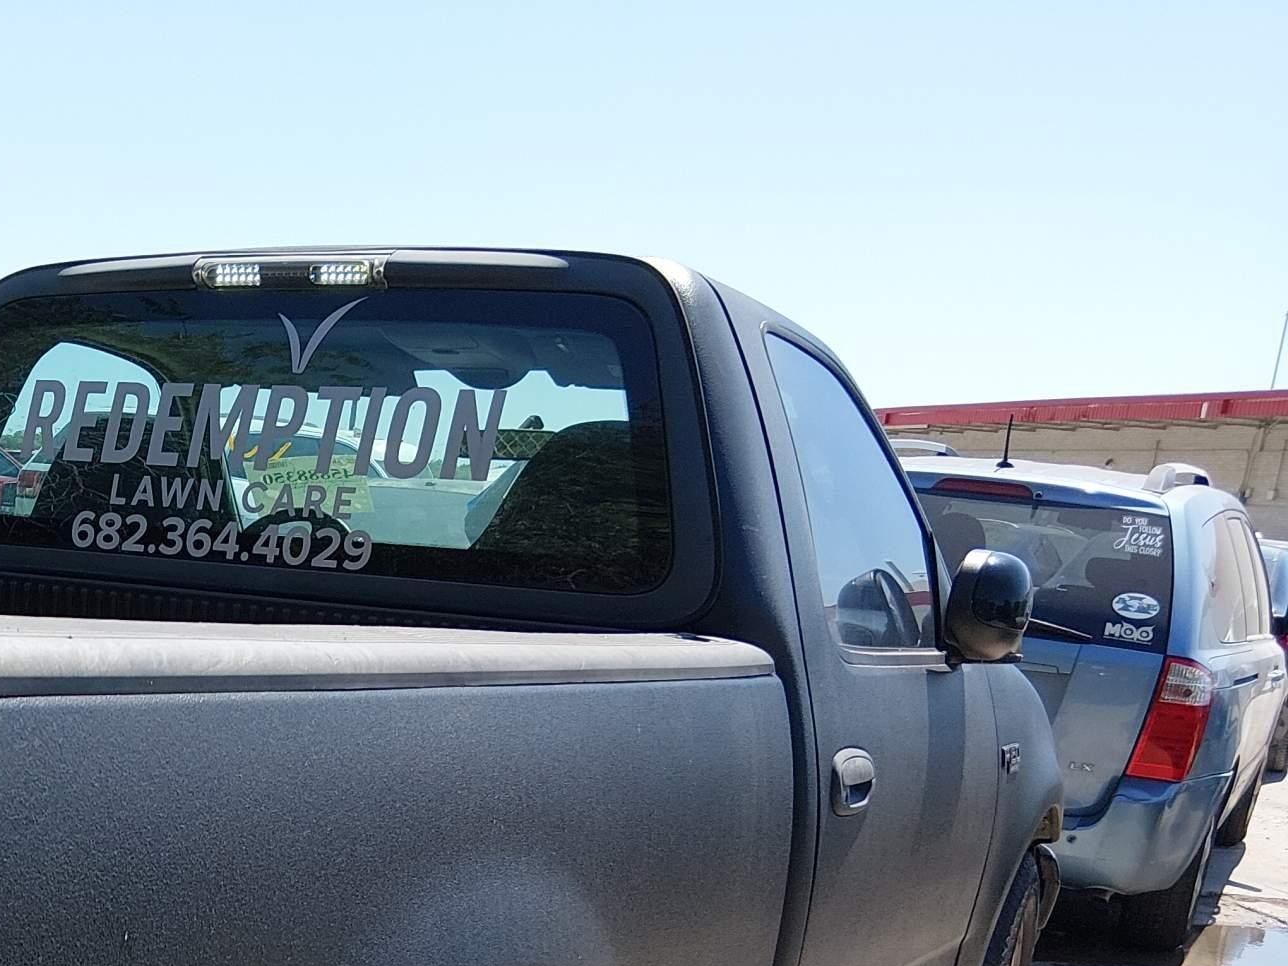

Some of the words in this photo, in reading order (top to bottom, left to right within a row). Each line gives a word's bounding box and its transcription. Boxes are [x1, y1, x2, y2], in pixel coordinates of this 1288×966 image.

[20, 379, 508, 481] REDEMPTION
[109, 473, 224, 511] LAWN
[242, 481, 357, 519] CARE
[1122, 516, 1132, 524] DO
[1135, 518, 1148, 526] YOU
[1139, 526, 1162, 534] FOLLOW
[71, 510, 372, 571] 682.364.4029
[1113, 525, 1165, 549] Jesus
[1069, 761, 1094, 772] LX
